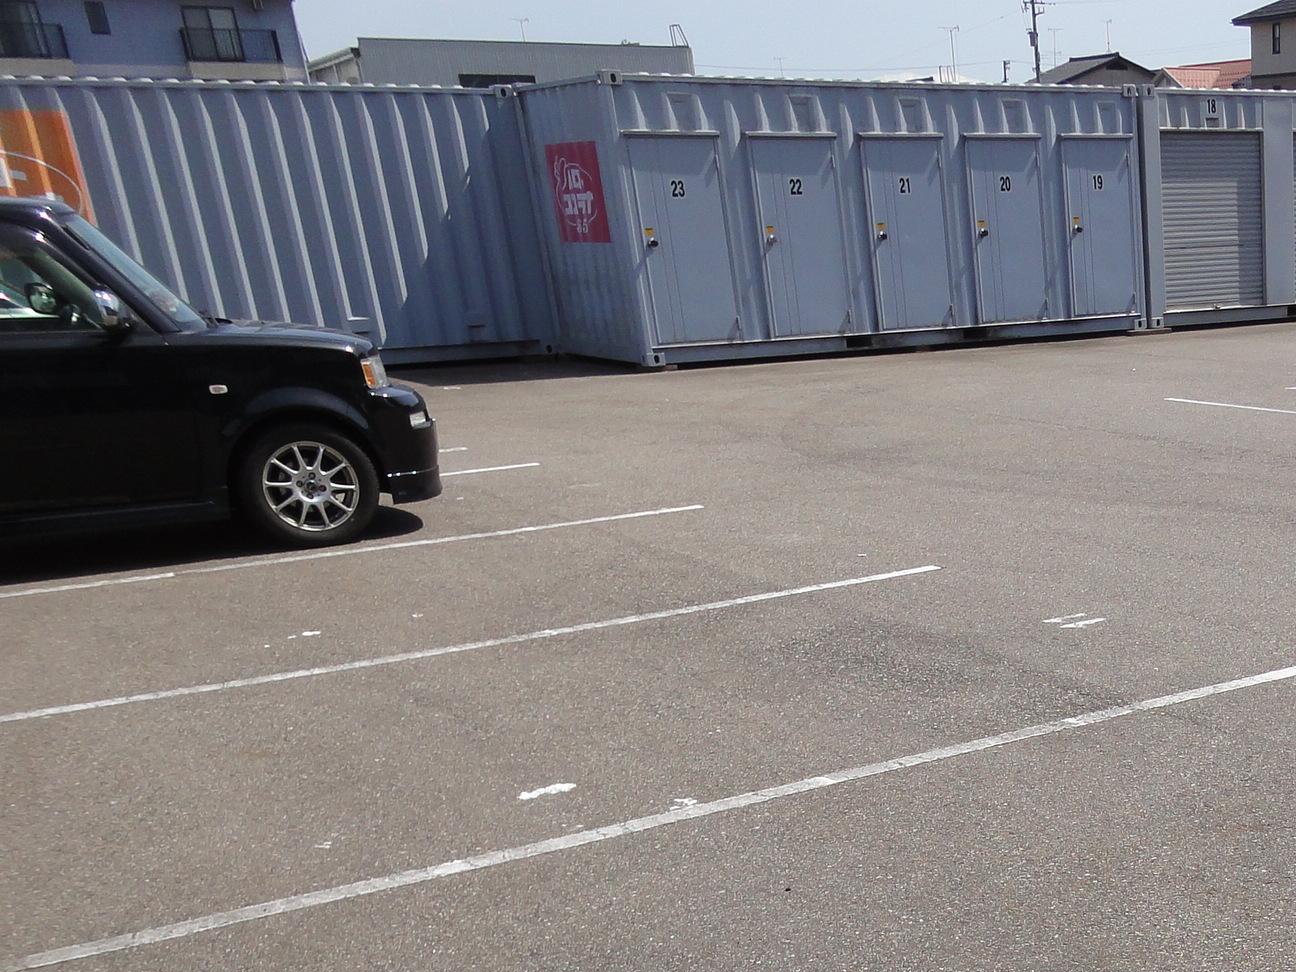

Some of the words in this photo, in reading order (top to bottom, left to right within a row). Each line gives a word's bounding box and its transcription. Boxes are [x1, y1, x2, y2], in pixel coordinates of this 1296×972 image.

[1206, 99, 1217, 114] 18
[670, 180, 686, 198] 23
[789, 178, 803, 196] 22
[899, 177, 911, 194] 21
[1000, 176, 1011, 192] 20
[1093, 175, 1103, 190] 19
